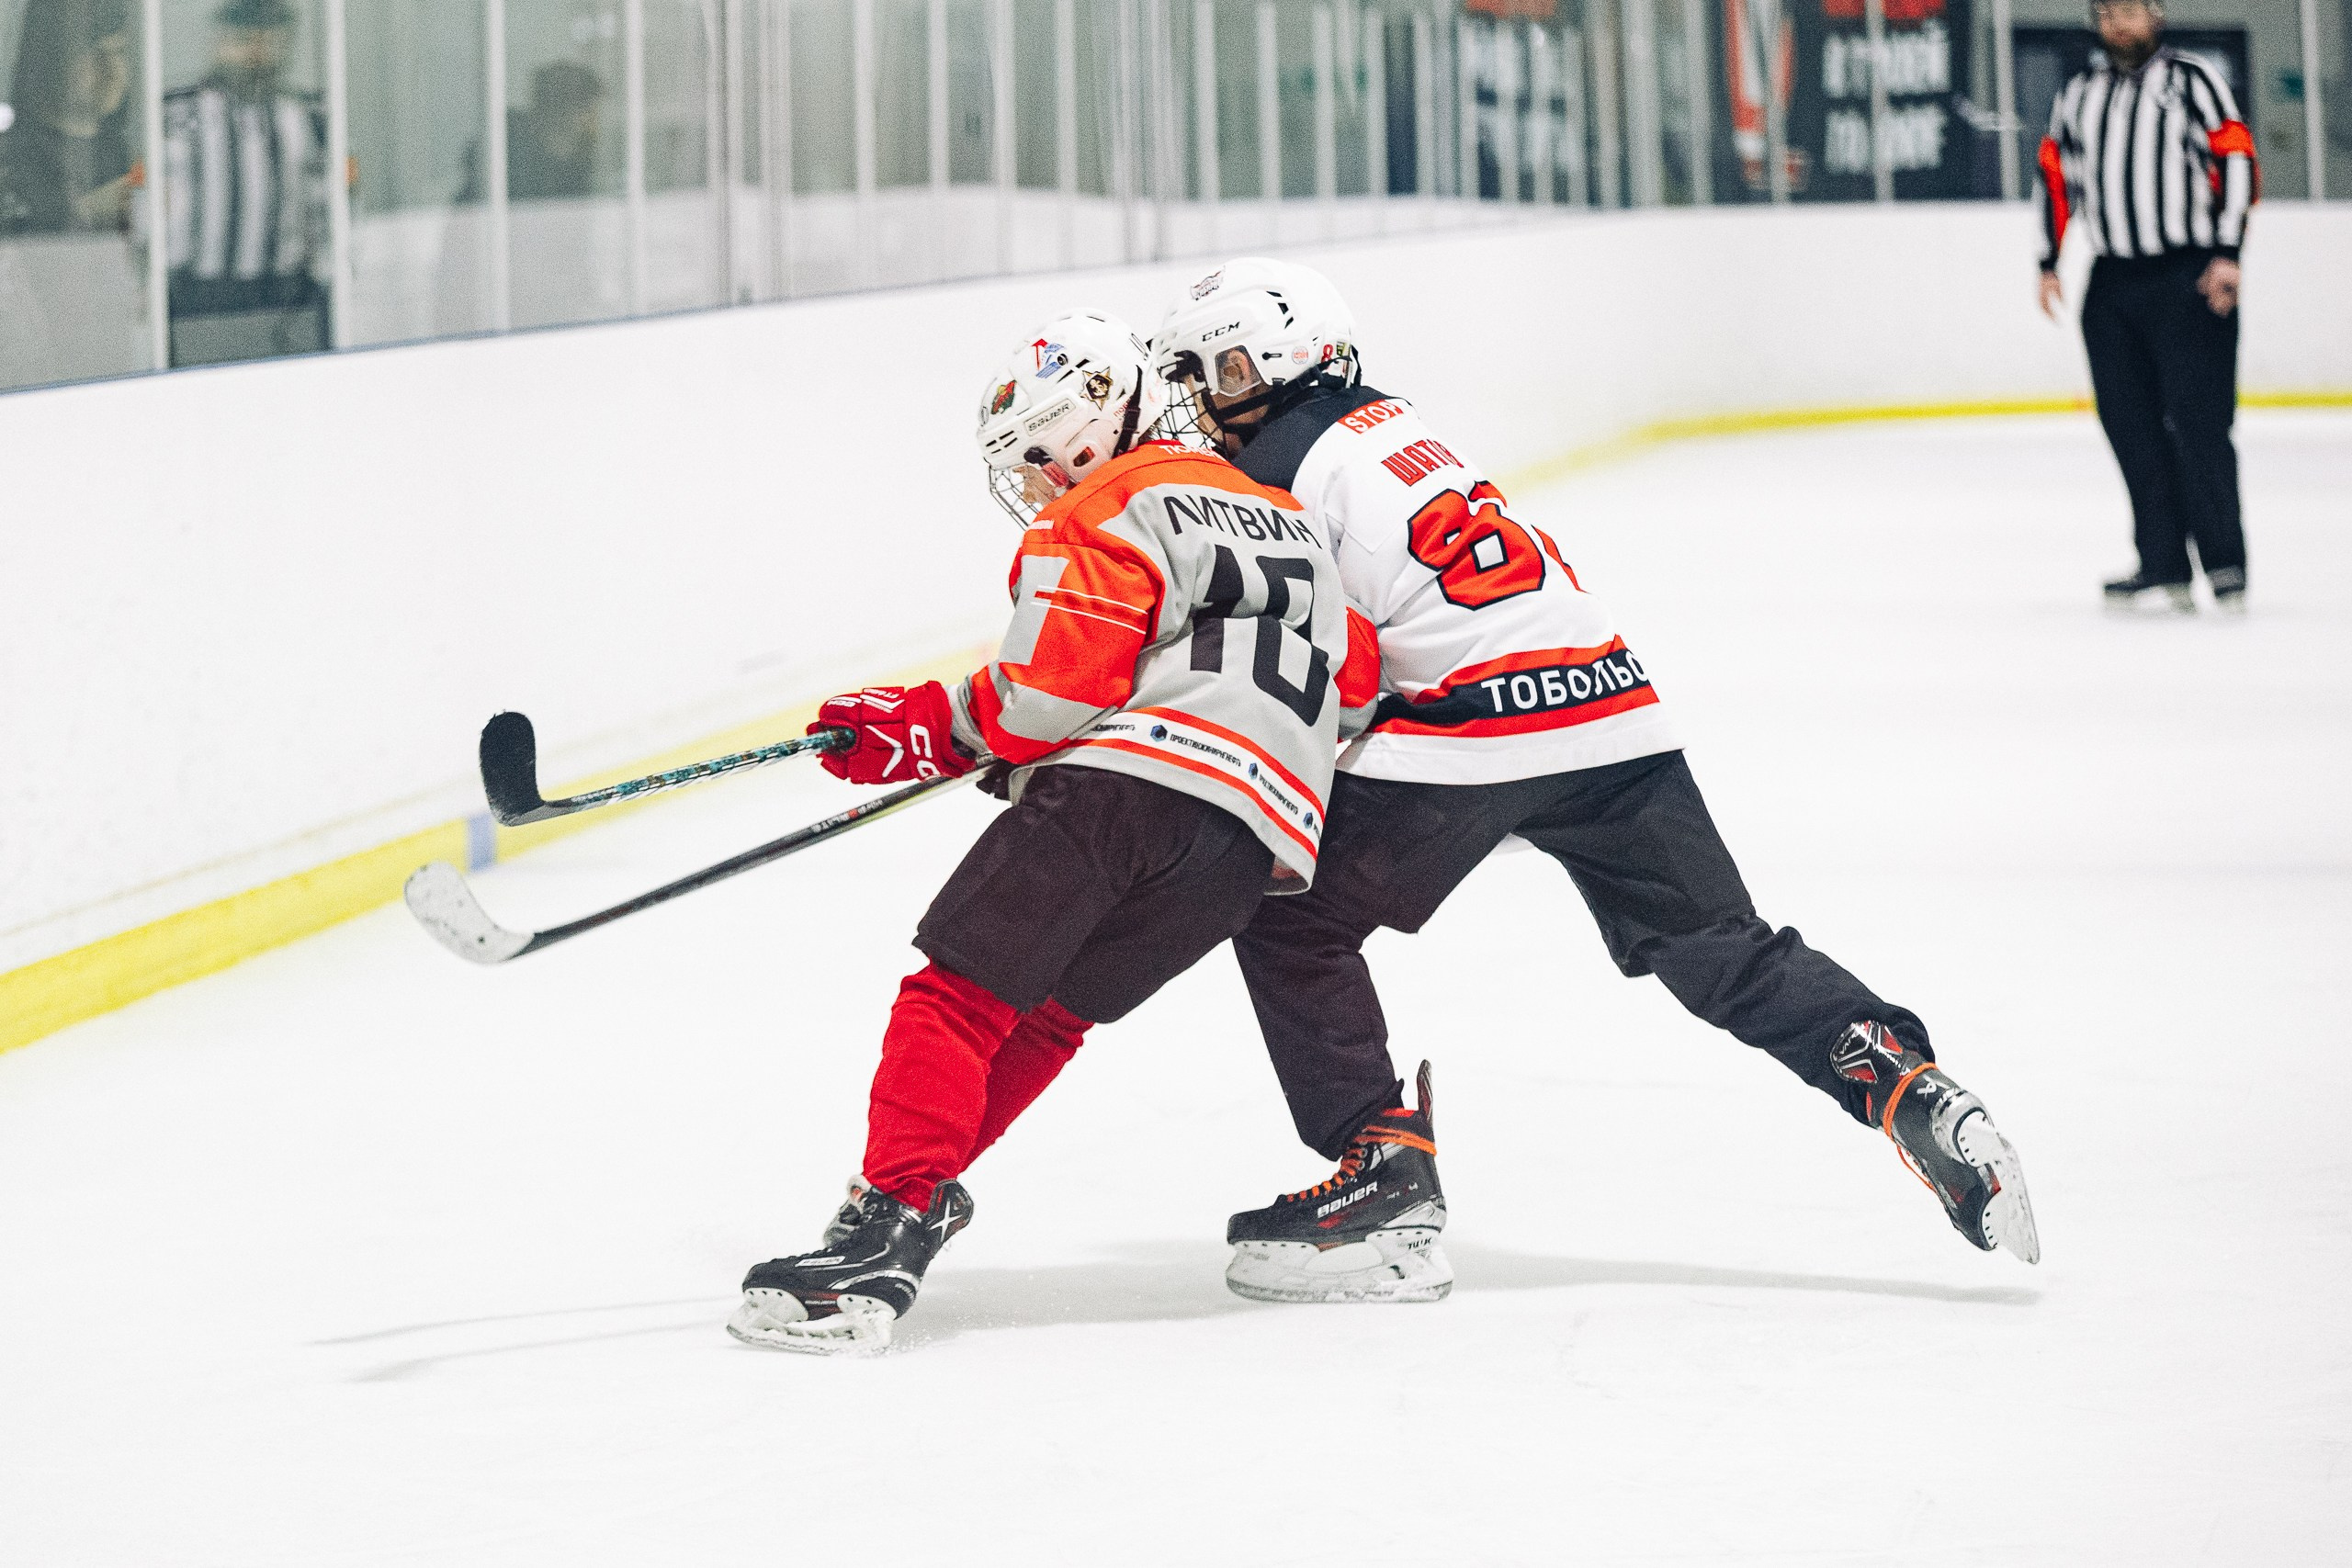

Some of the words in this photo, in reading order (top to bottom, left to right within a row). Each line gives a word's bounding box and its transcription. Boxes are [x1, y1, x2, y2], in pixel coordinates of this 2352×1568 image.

[1202, 321, 1240, 342] CCM
[1344, 400, 1400, 433] STOP
[1163, 494, 1323, 549] ЛИТВИН
[1317, 1181, 1378, 1219] BAUER
